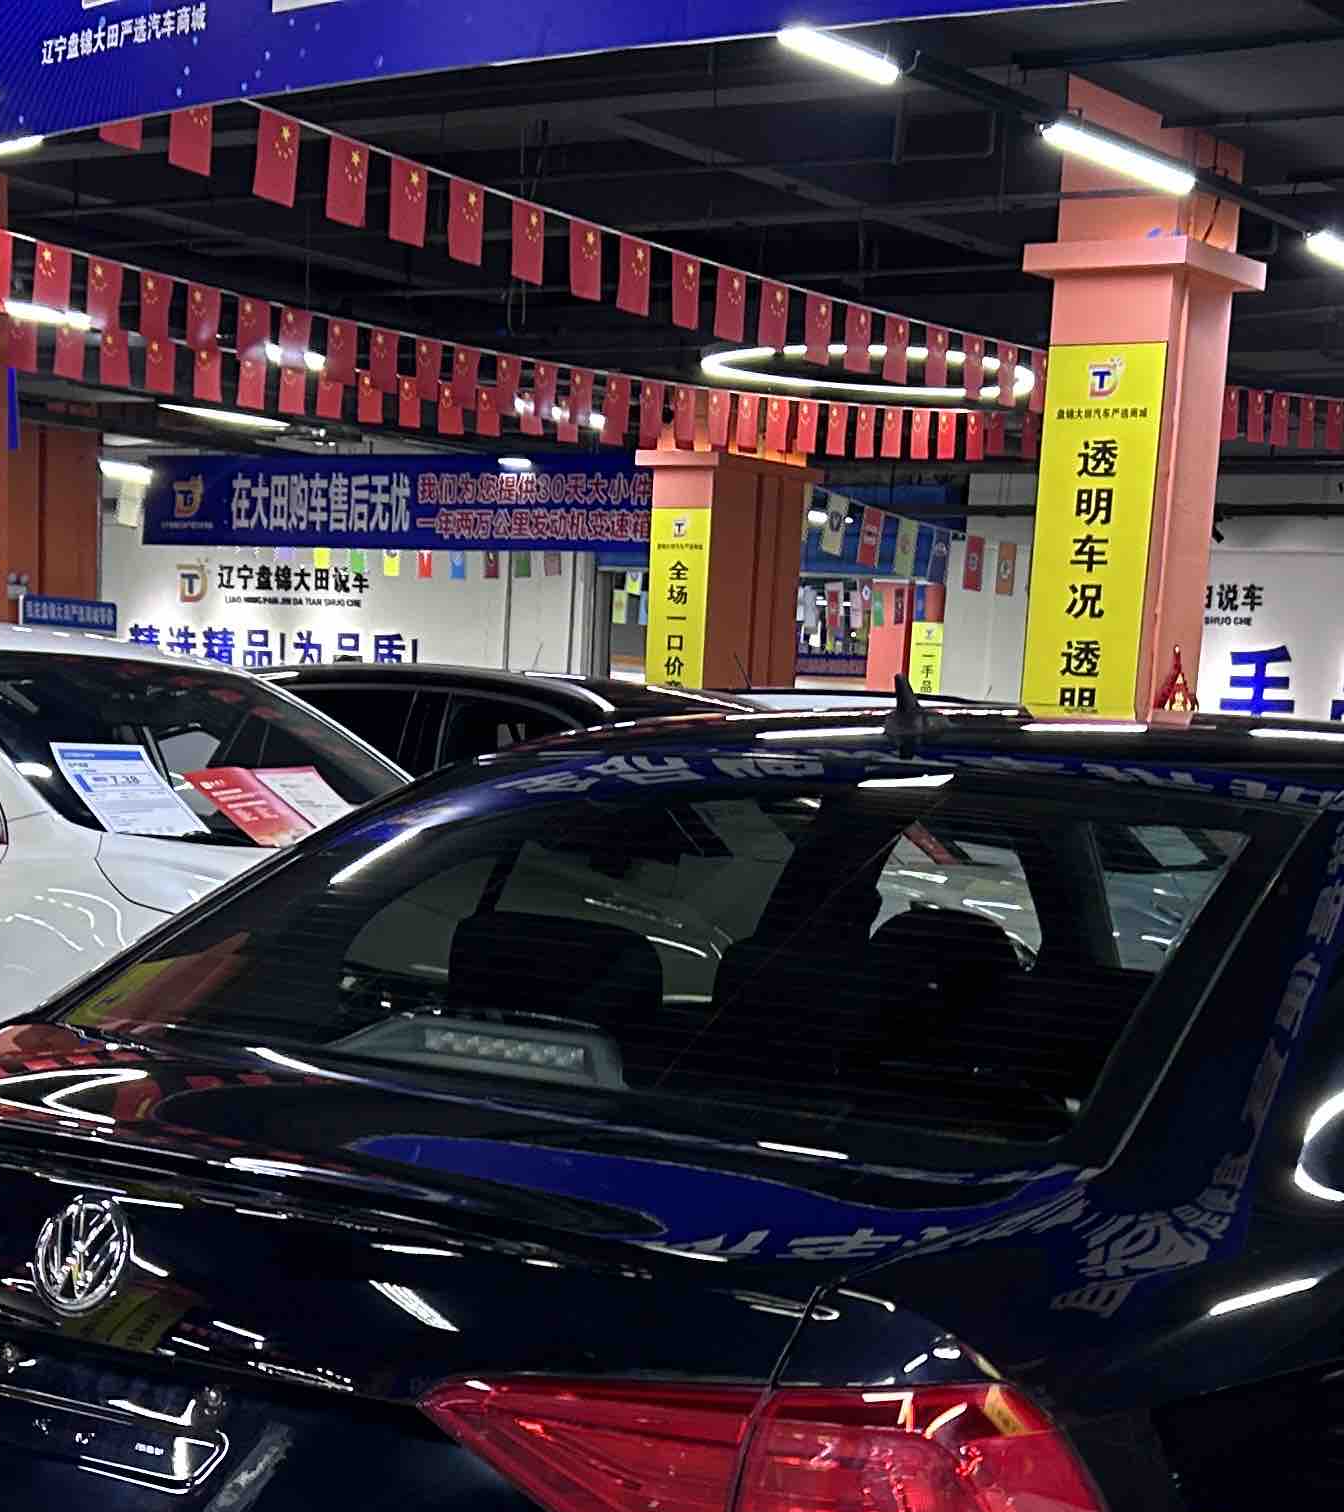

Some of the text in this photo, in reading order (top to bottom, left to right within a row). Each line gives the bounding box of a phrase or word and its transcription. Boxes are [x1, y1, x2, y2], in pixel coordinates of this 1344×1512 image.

[41, 2, 207, 65] 辽宁盘锦大田严选汽车商城
[230, 472, 411, 533] 在大田购车售后无忧
[1064, 439, 1119, 619] 透明车况
[217, 564, 370, 594] 辽宁盘锦大田说车
[664, 560, 689, 688] 全场一口价
